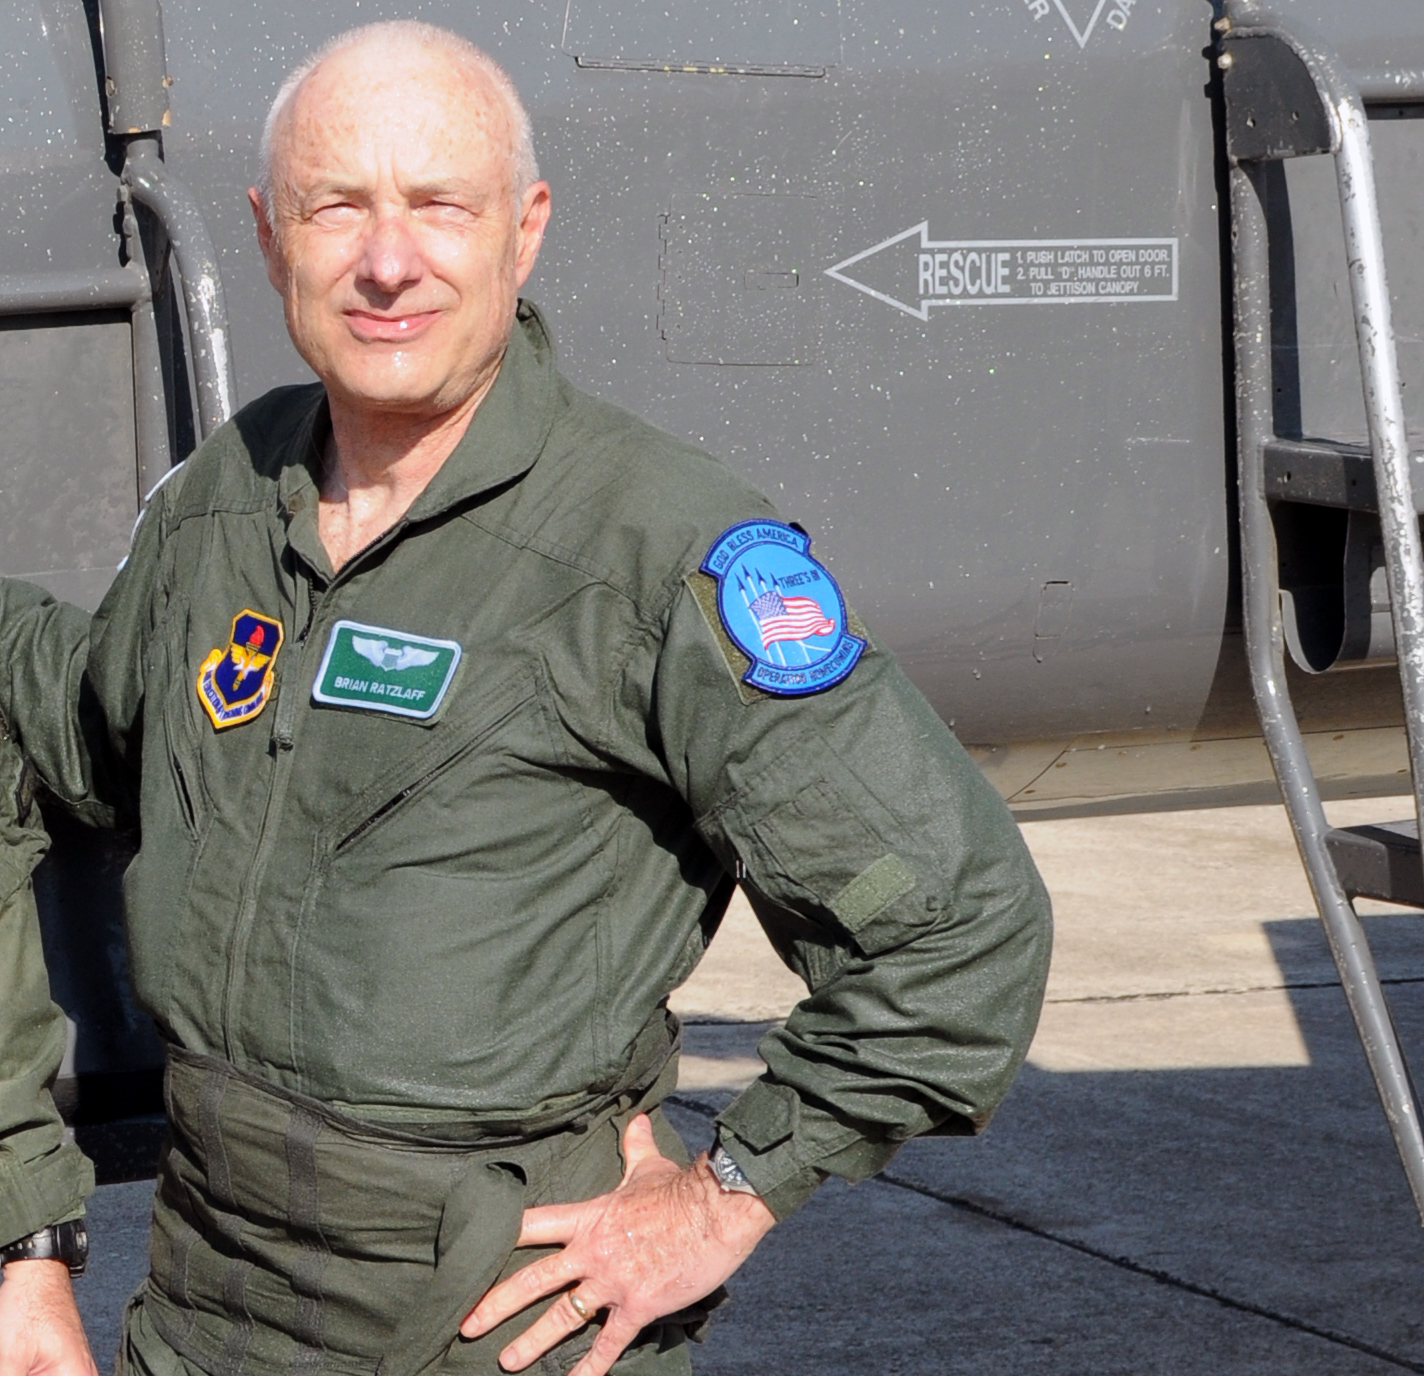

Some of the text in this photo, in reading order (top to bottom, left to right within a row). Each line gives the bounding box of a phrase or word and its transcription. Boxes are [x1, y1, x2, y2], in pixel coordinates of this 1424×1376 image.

[1016, 248, 1170, 264] 1. PUSH LATCH TO OPEN DOOR.
[918, 251, 1011, 295] RESCUE
[1029, 266, 1054, 279] PULL
[1078, 265, 1118, 279] HANDLE
[1120, 265, 1141, 278] OUT
[1144, 265, 1152, 278] 6
[1154, 265, 1170, 278] FT.
[1030, 280, 1139, 295] TO JETTISON CANOPY
[712, 528, 799, 569] GOD BLESS AMERICA
[777, 571, 811, 590] THREE'S
[757, 640, 855, 684] OPERATION HOMECOMING
[334, 676, 426, 701] BRIAN RATZLAFF
